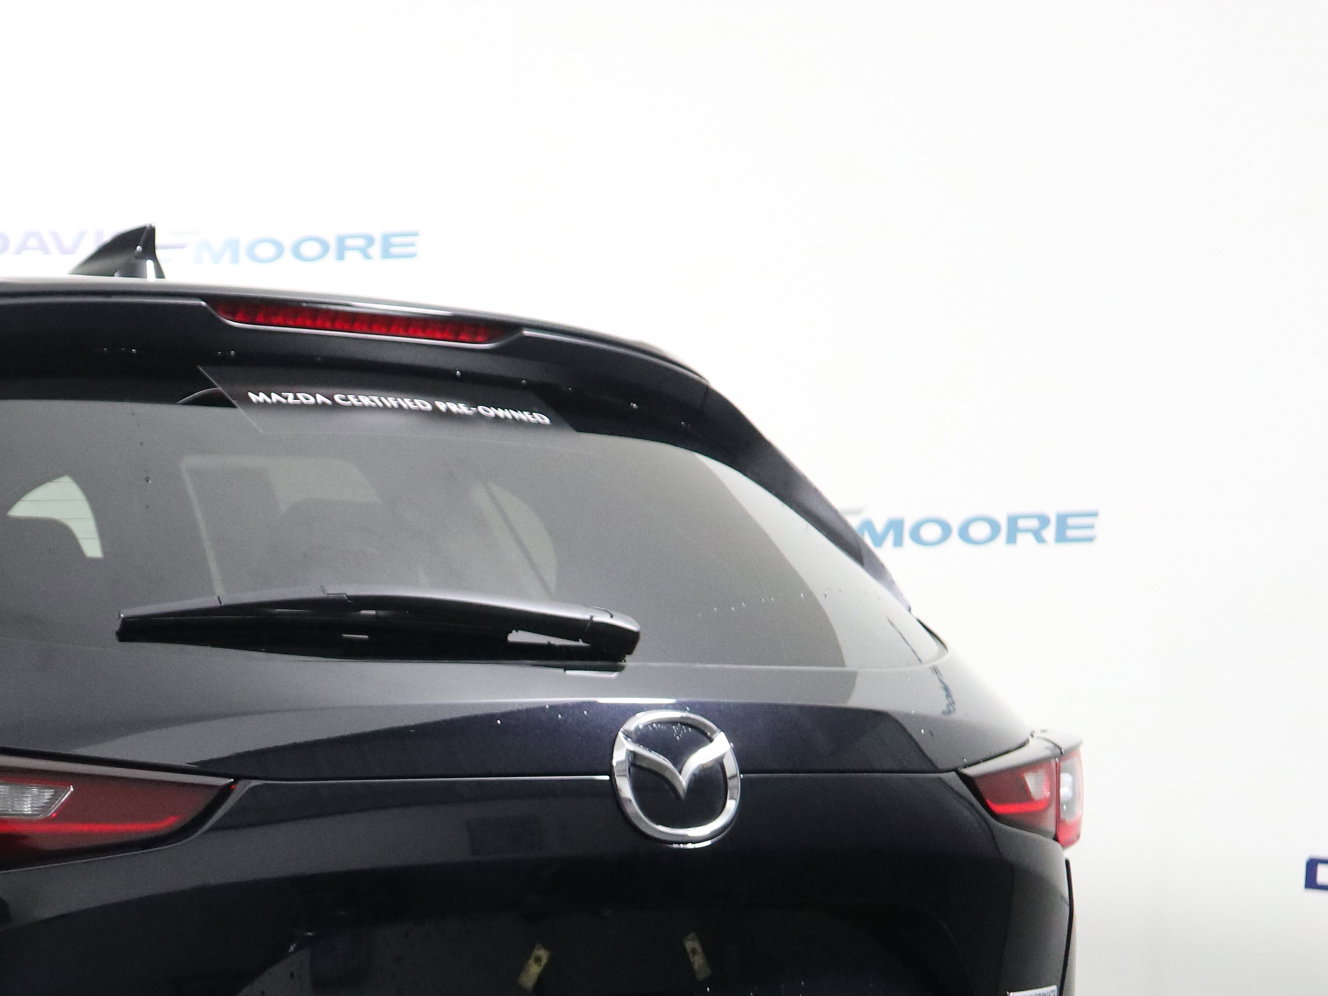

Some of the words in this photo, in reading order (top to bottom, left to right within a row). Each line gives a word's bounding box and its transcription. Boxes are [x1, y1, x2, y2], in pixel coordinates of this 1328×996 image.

[193, 230, 420, 265] MOORE
[247, 391, 332, 406] MAZDA
[333, 394, 433, 412] CERTIFIED
[434, 400, 552, 425] PRE-OWNED
[856, 509, 1099, 548] MOORE
